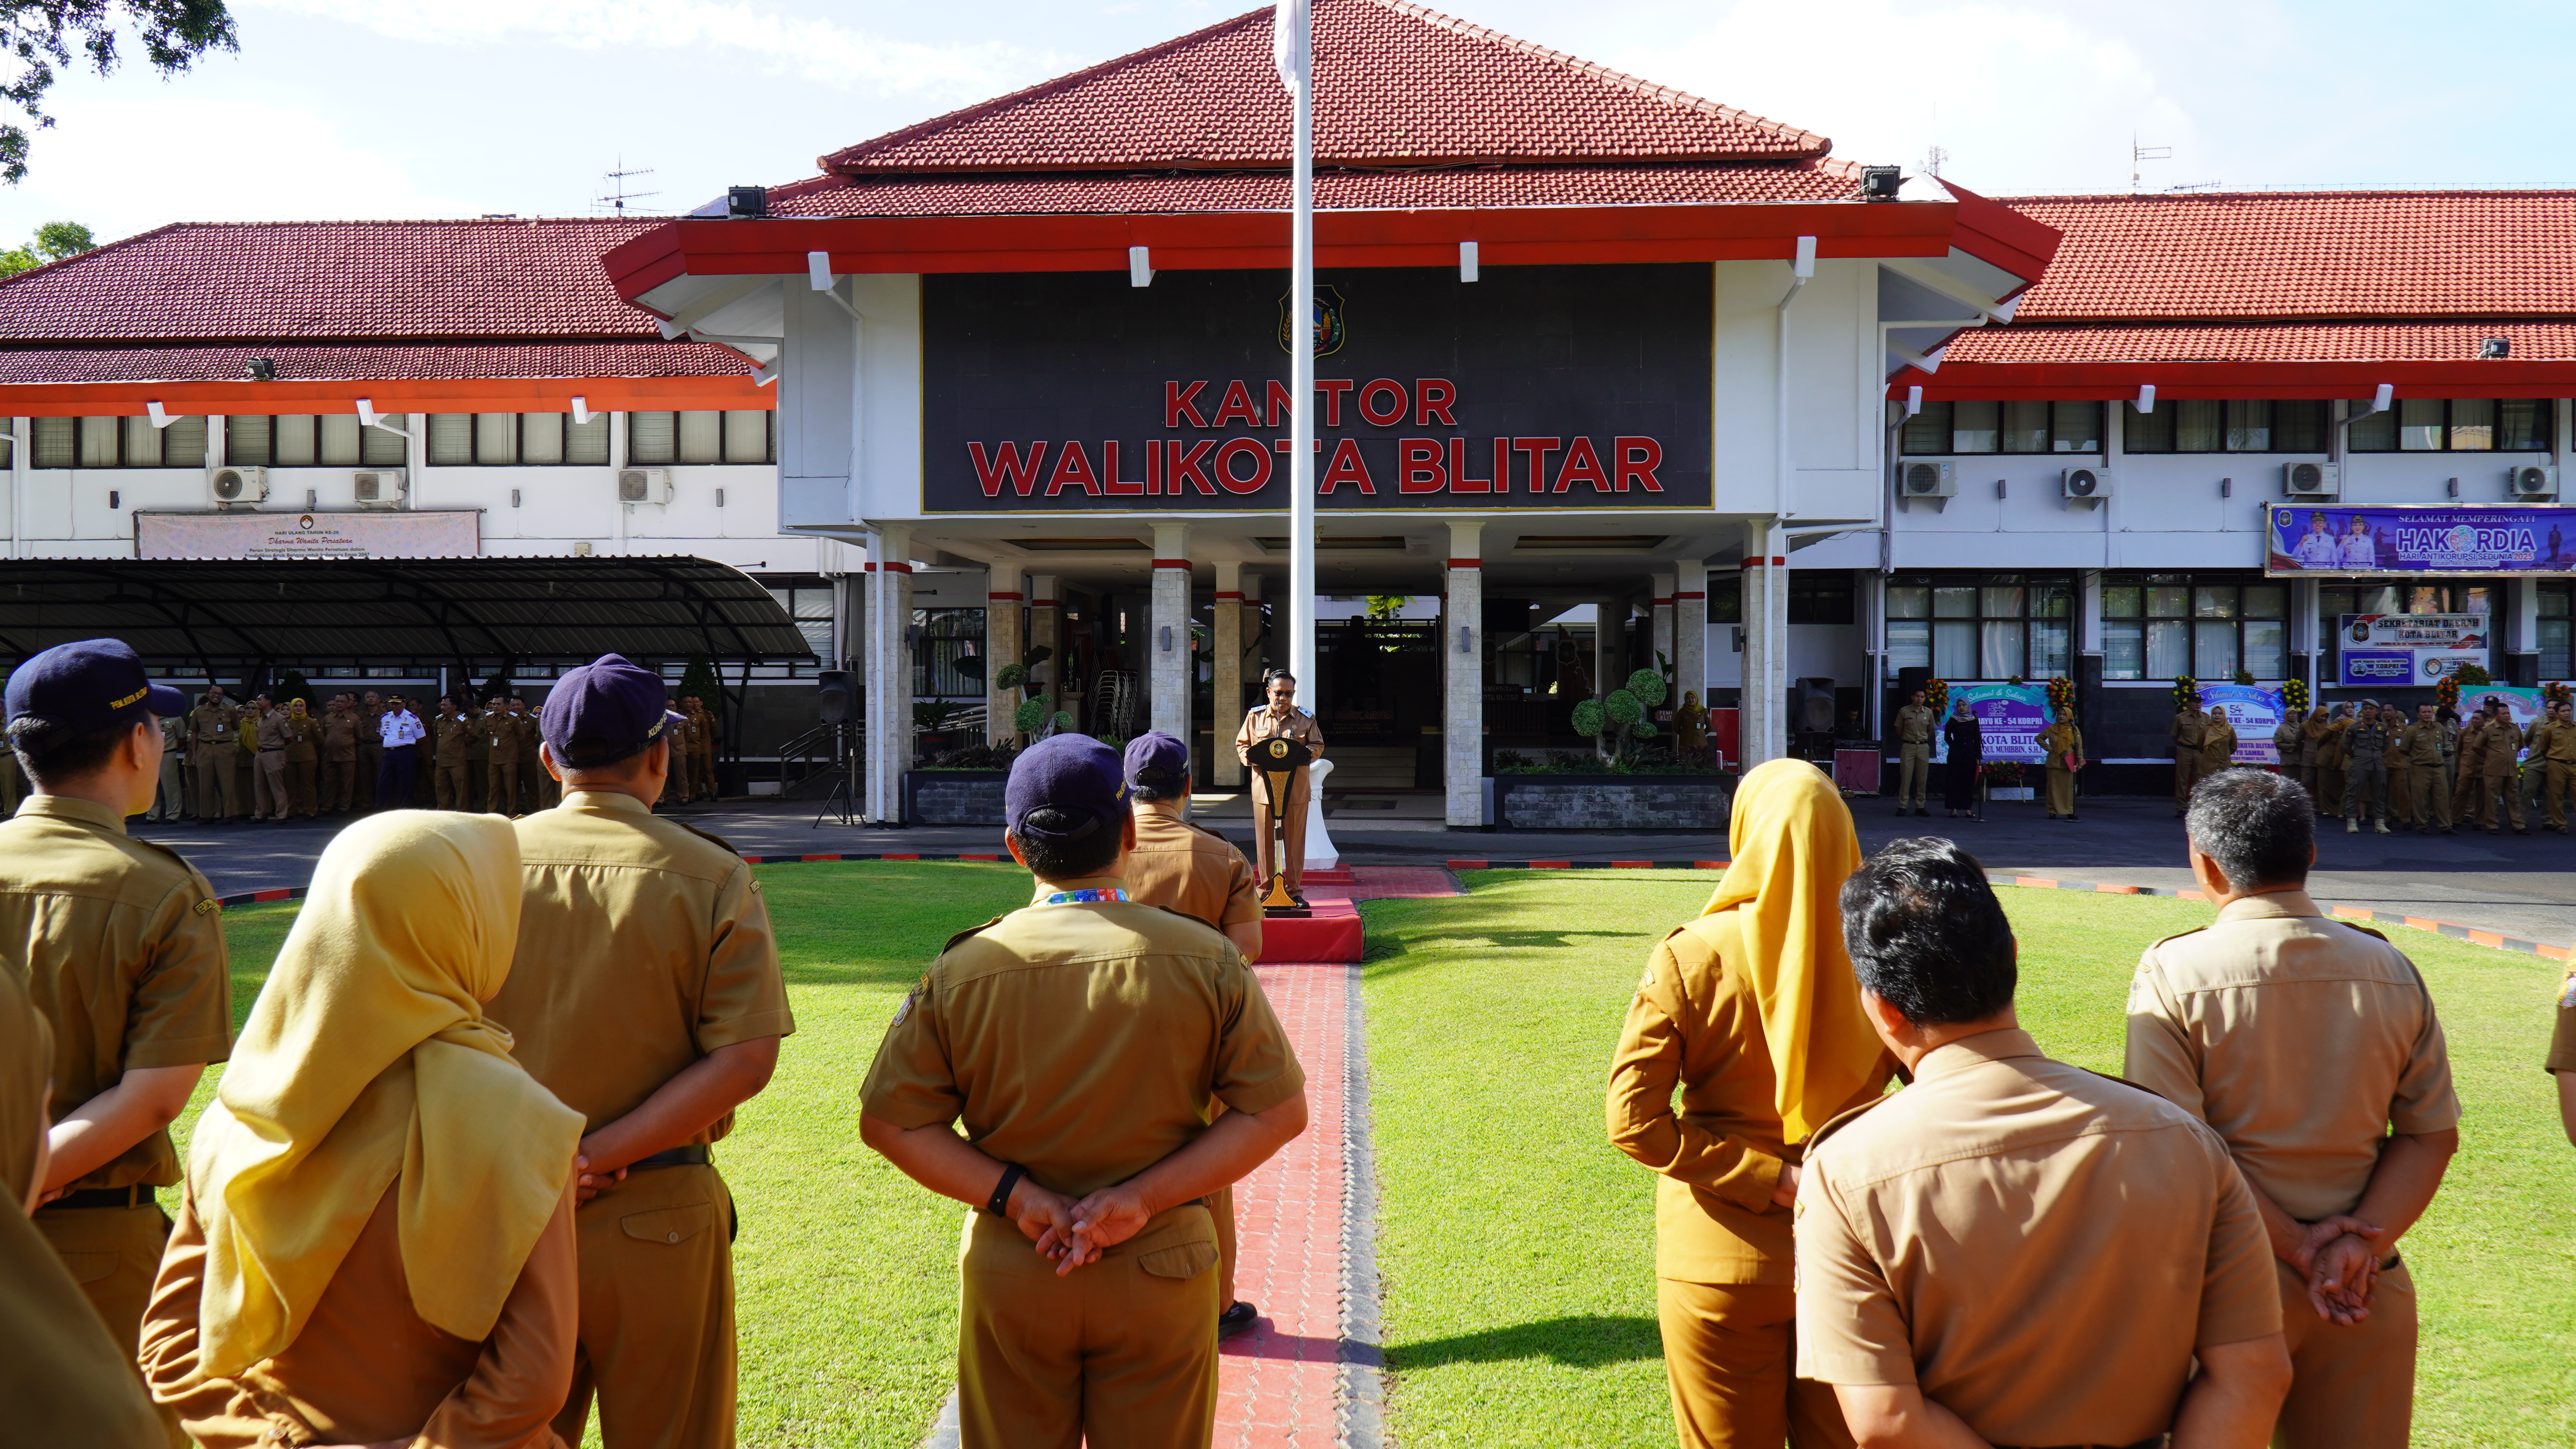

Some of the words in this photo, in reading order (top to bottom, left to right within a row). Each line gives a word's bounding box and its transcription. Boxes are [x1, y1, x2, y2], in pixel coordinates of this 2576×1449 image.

[1166, 378, 1458, 427] KANTOR
[967, 437, 1376, 497] WALIKOA
[1399, 436, 1664, 494] BLITAR
[2378, 619, 2441, 628] SEKRETARIAT
[2442, 618, 2479, 627] DAERAH
[2398, 630, 2423, 639] KOTA
[2424, 630, 2458, 639] BLITAR
[1967, 689, 1994, 702] Selamat
[2208, 689, 2235, 700] Selamat
[2236, 688, 2243, 698] &
[1334, 710, 1394, 720] SOEKARNO
[1981, 735, 2008, 744] KOTA
[2011, 735, 2036, 744] BLIT
[1996, 746, 2027, 754] MUHIBBIN,
